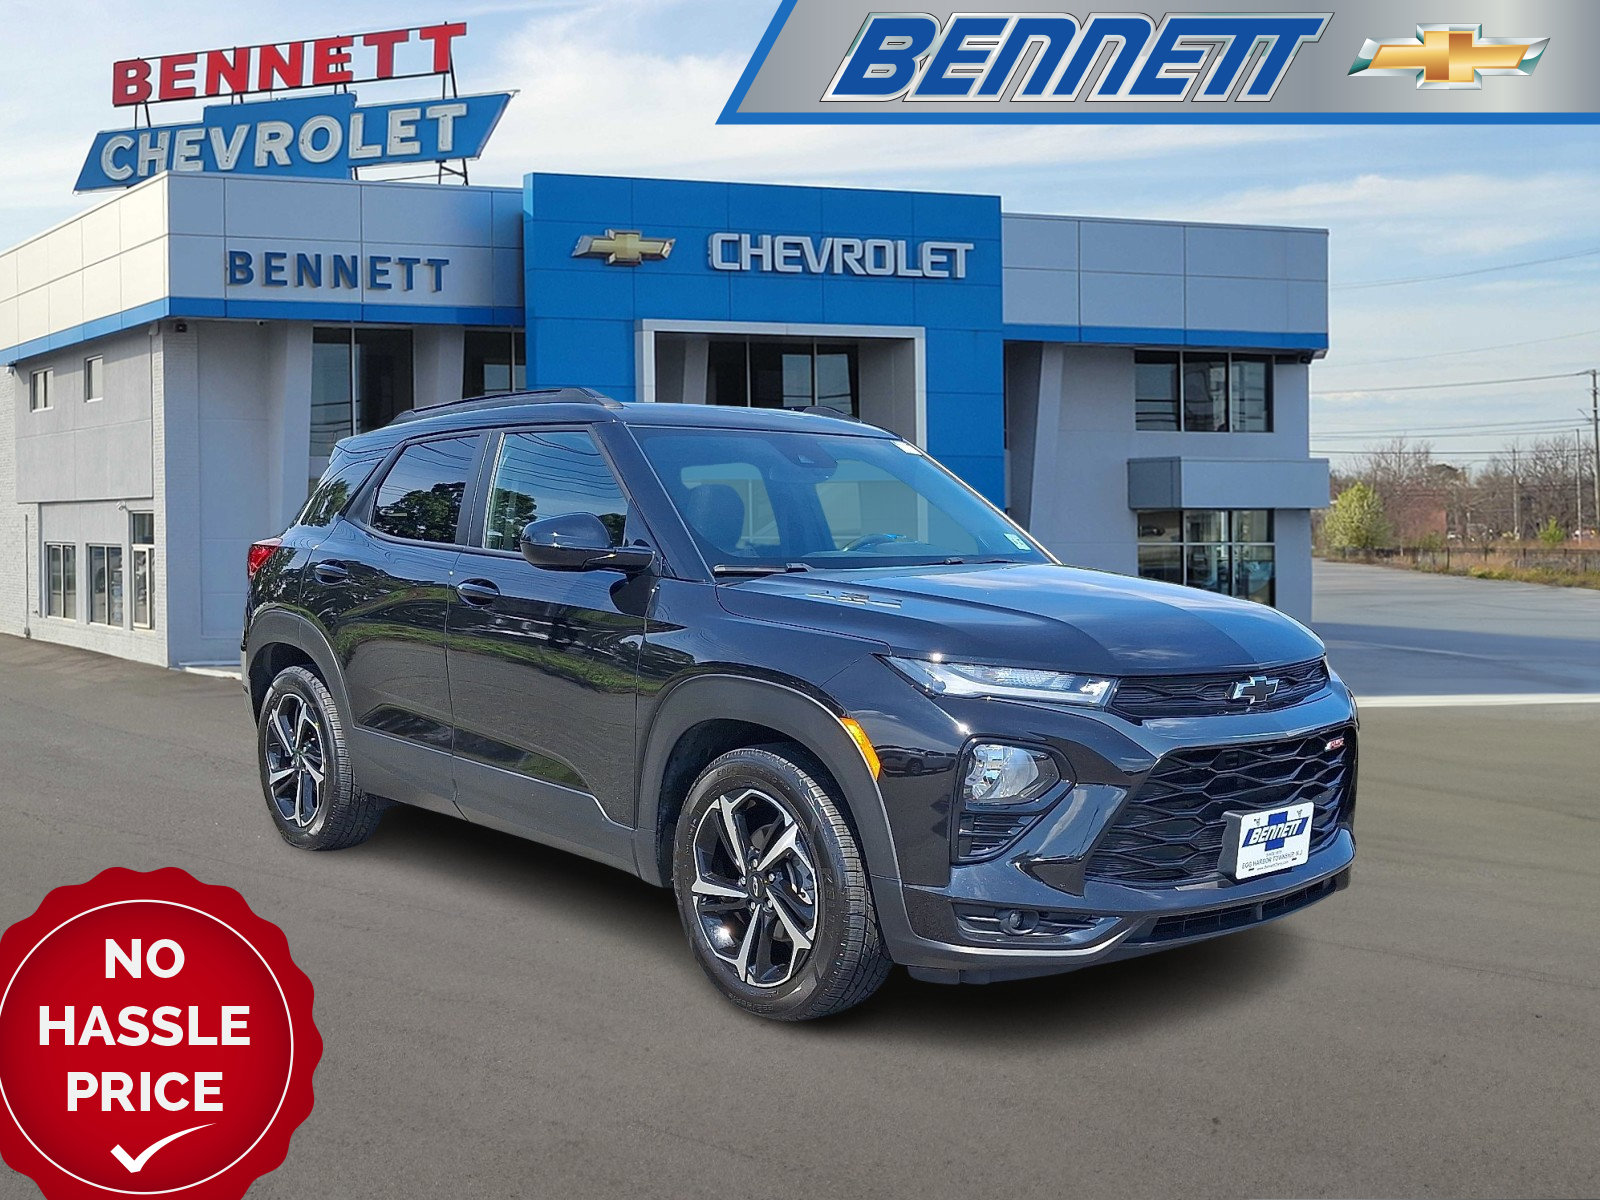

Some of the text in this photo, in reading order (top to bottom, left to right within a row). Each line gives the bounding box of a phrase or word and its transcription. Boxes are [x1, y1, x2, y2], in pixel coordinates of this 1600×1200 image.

[112, 22, 467, 107] BENNETT
[101, 102, 468, 181] CHEVROLET
[227, 250, 450, 292] BENNETT
[707, 232, 975, 279] CHEVROLET
[1248, 820, 1302, 845] BENNETT
